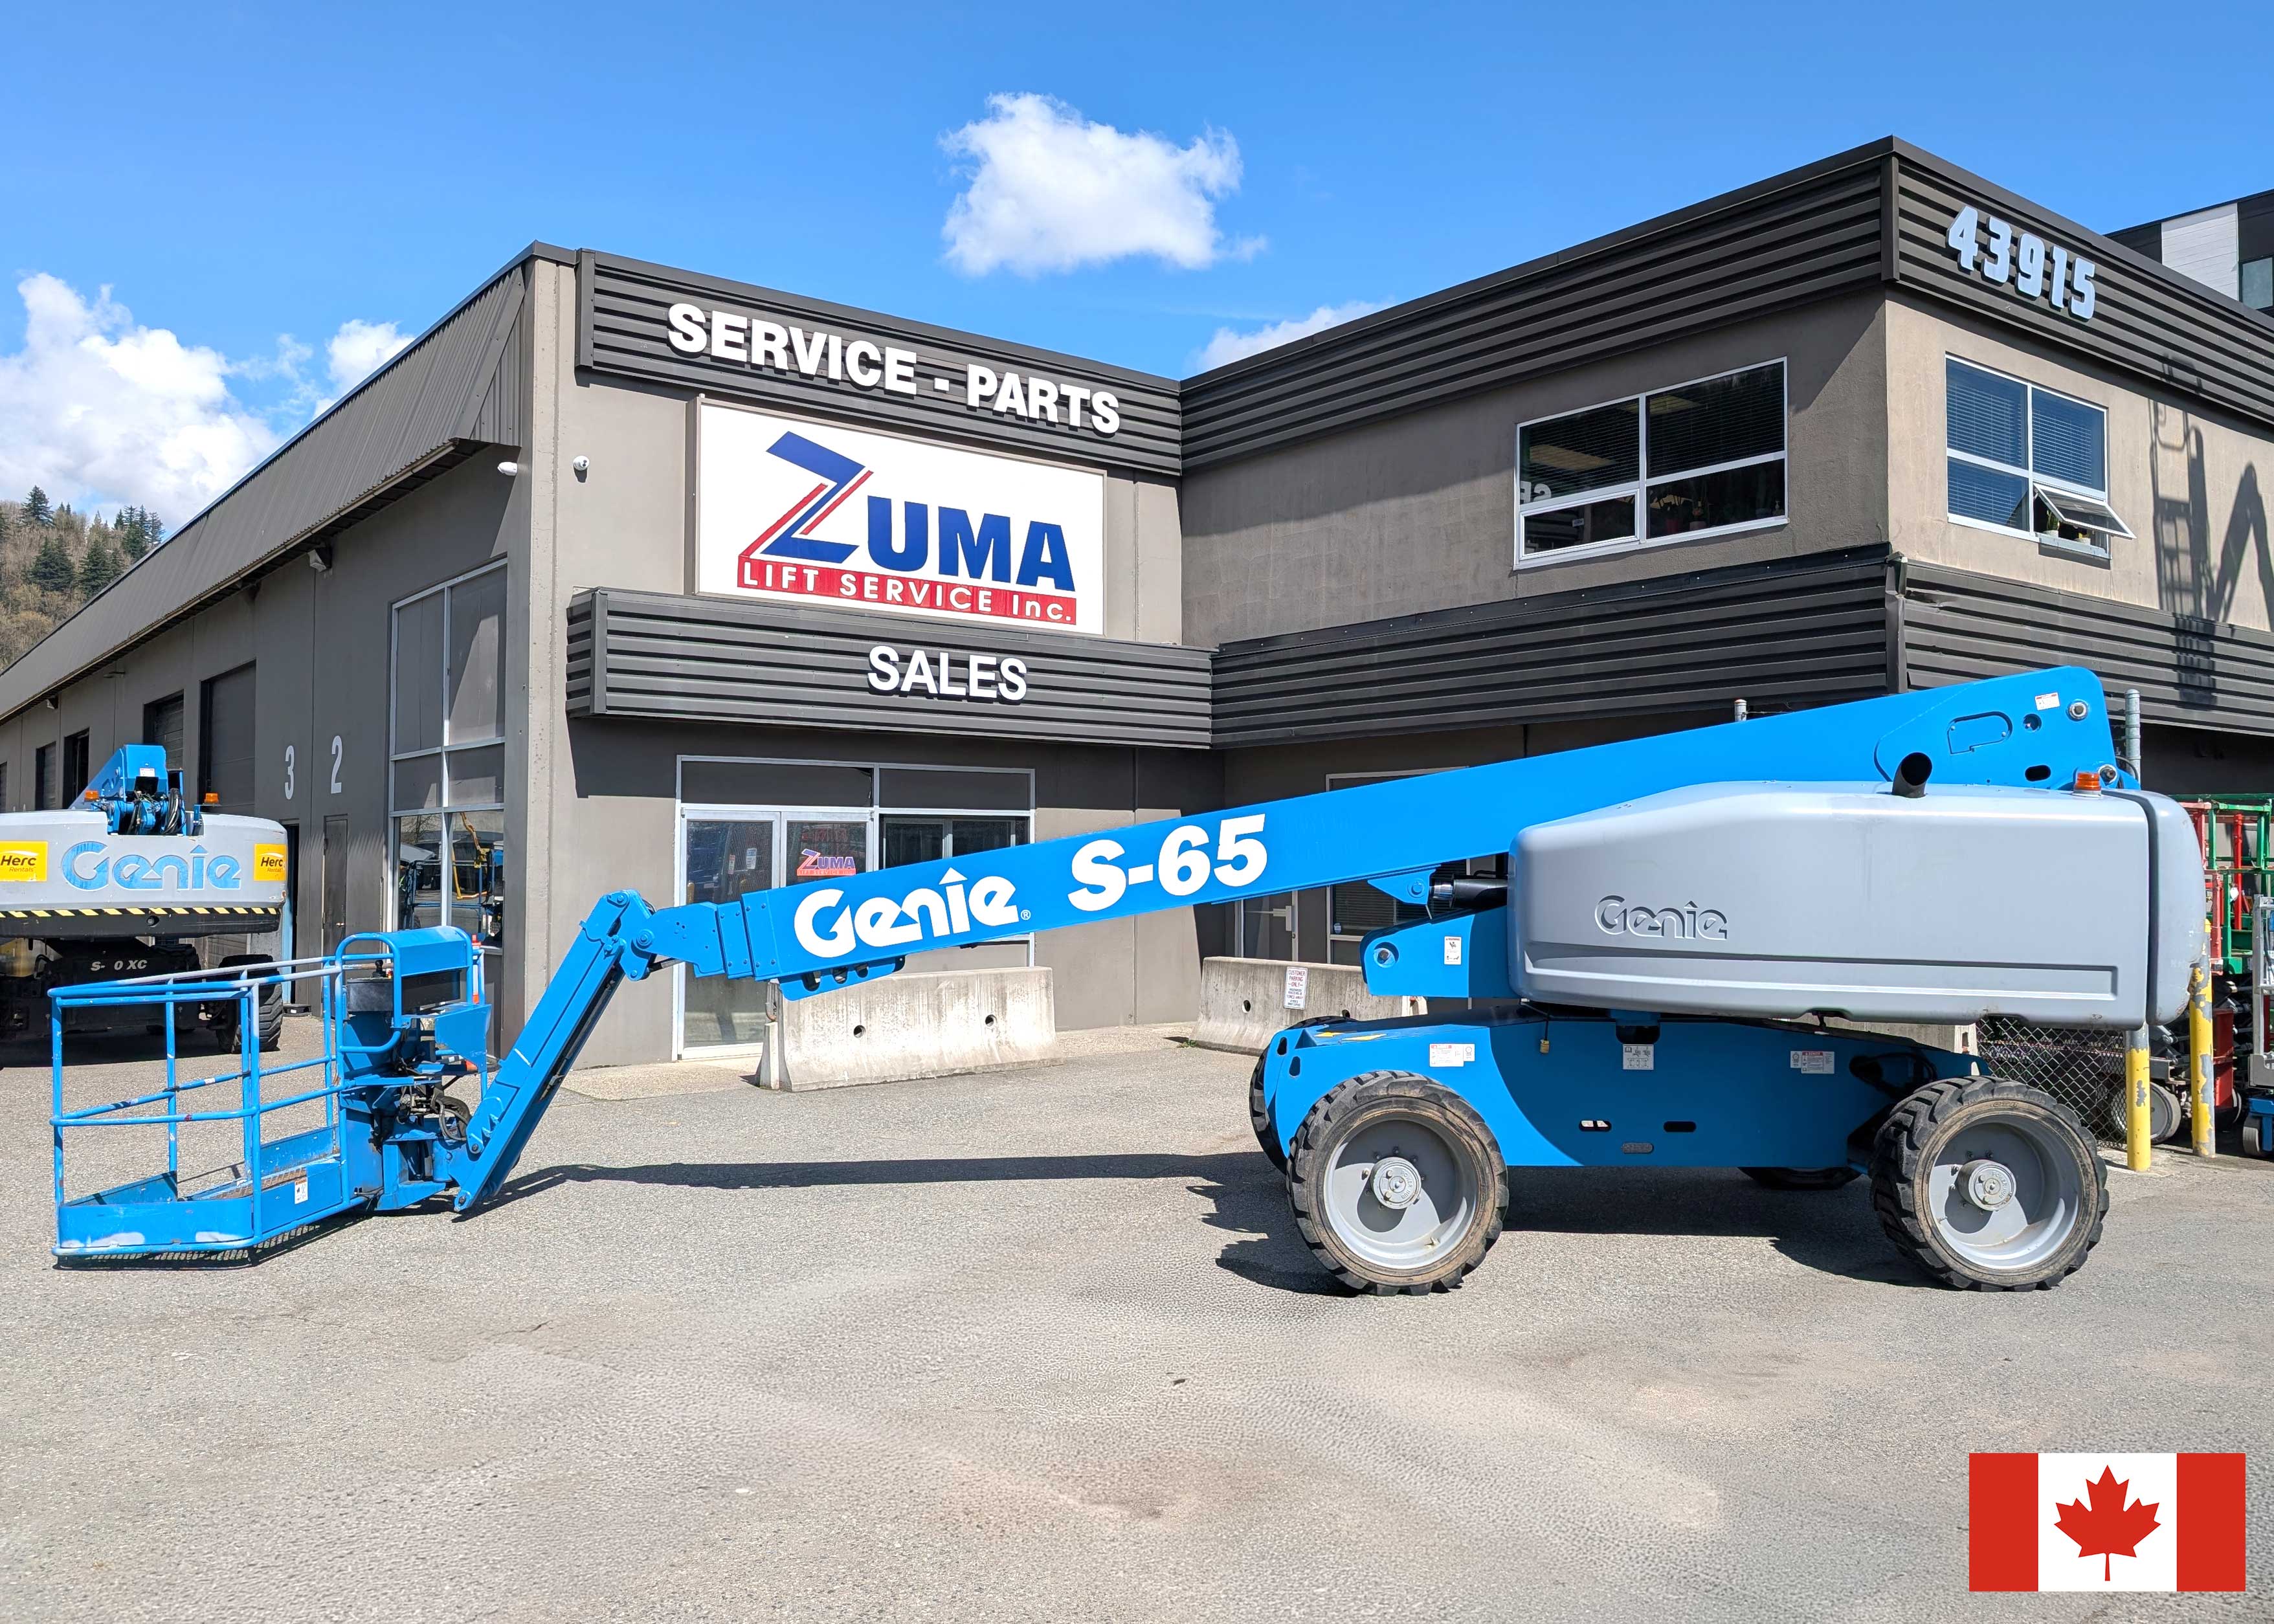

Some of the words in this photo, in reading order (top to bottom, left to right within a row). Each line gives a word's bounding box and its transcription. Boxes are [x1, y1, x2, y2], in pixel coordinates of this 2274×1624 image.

[1947, 205, 2096, 319] 43915
[668, 304, 917, 395] SERVICE
[934, 377, 950, 392] -
[968, 364, 1120, 434] PARTS
[761, 431, 1075, 592] ZUMA
[744, 561, 819, 592] LIFT
[840, 573, 992, 612] SERVICE
[1012, 594, 1073, 621] Inc.
[867, 646, 1027, 700] SALES
[285, 745, 295, 800] 3
[331, 735, 342, 794] 2
[0, 855, 37, 866] Herc
[60, 841, 241, 891] Genie
[260, 856, 284, 867] Herc
[801, 848, 856, 870] ZUMA
[1068, 814, 1267, 911] S-65
[1595, 895, 1728, 940] Genie
[126, 959, 148, 970] XC
